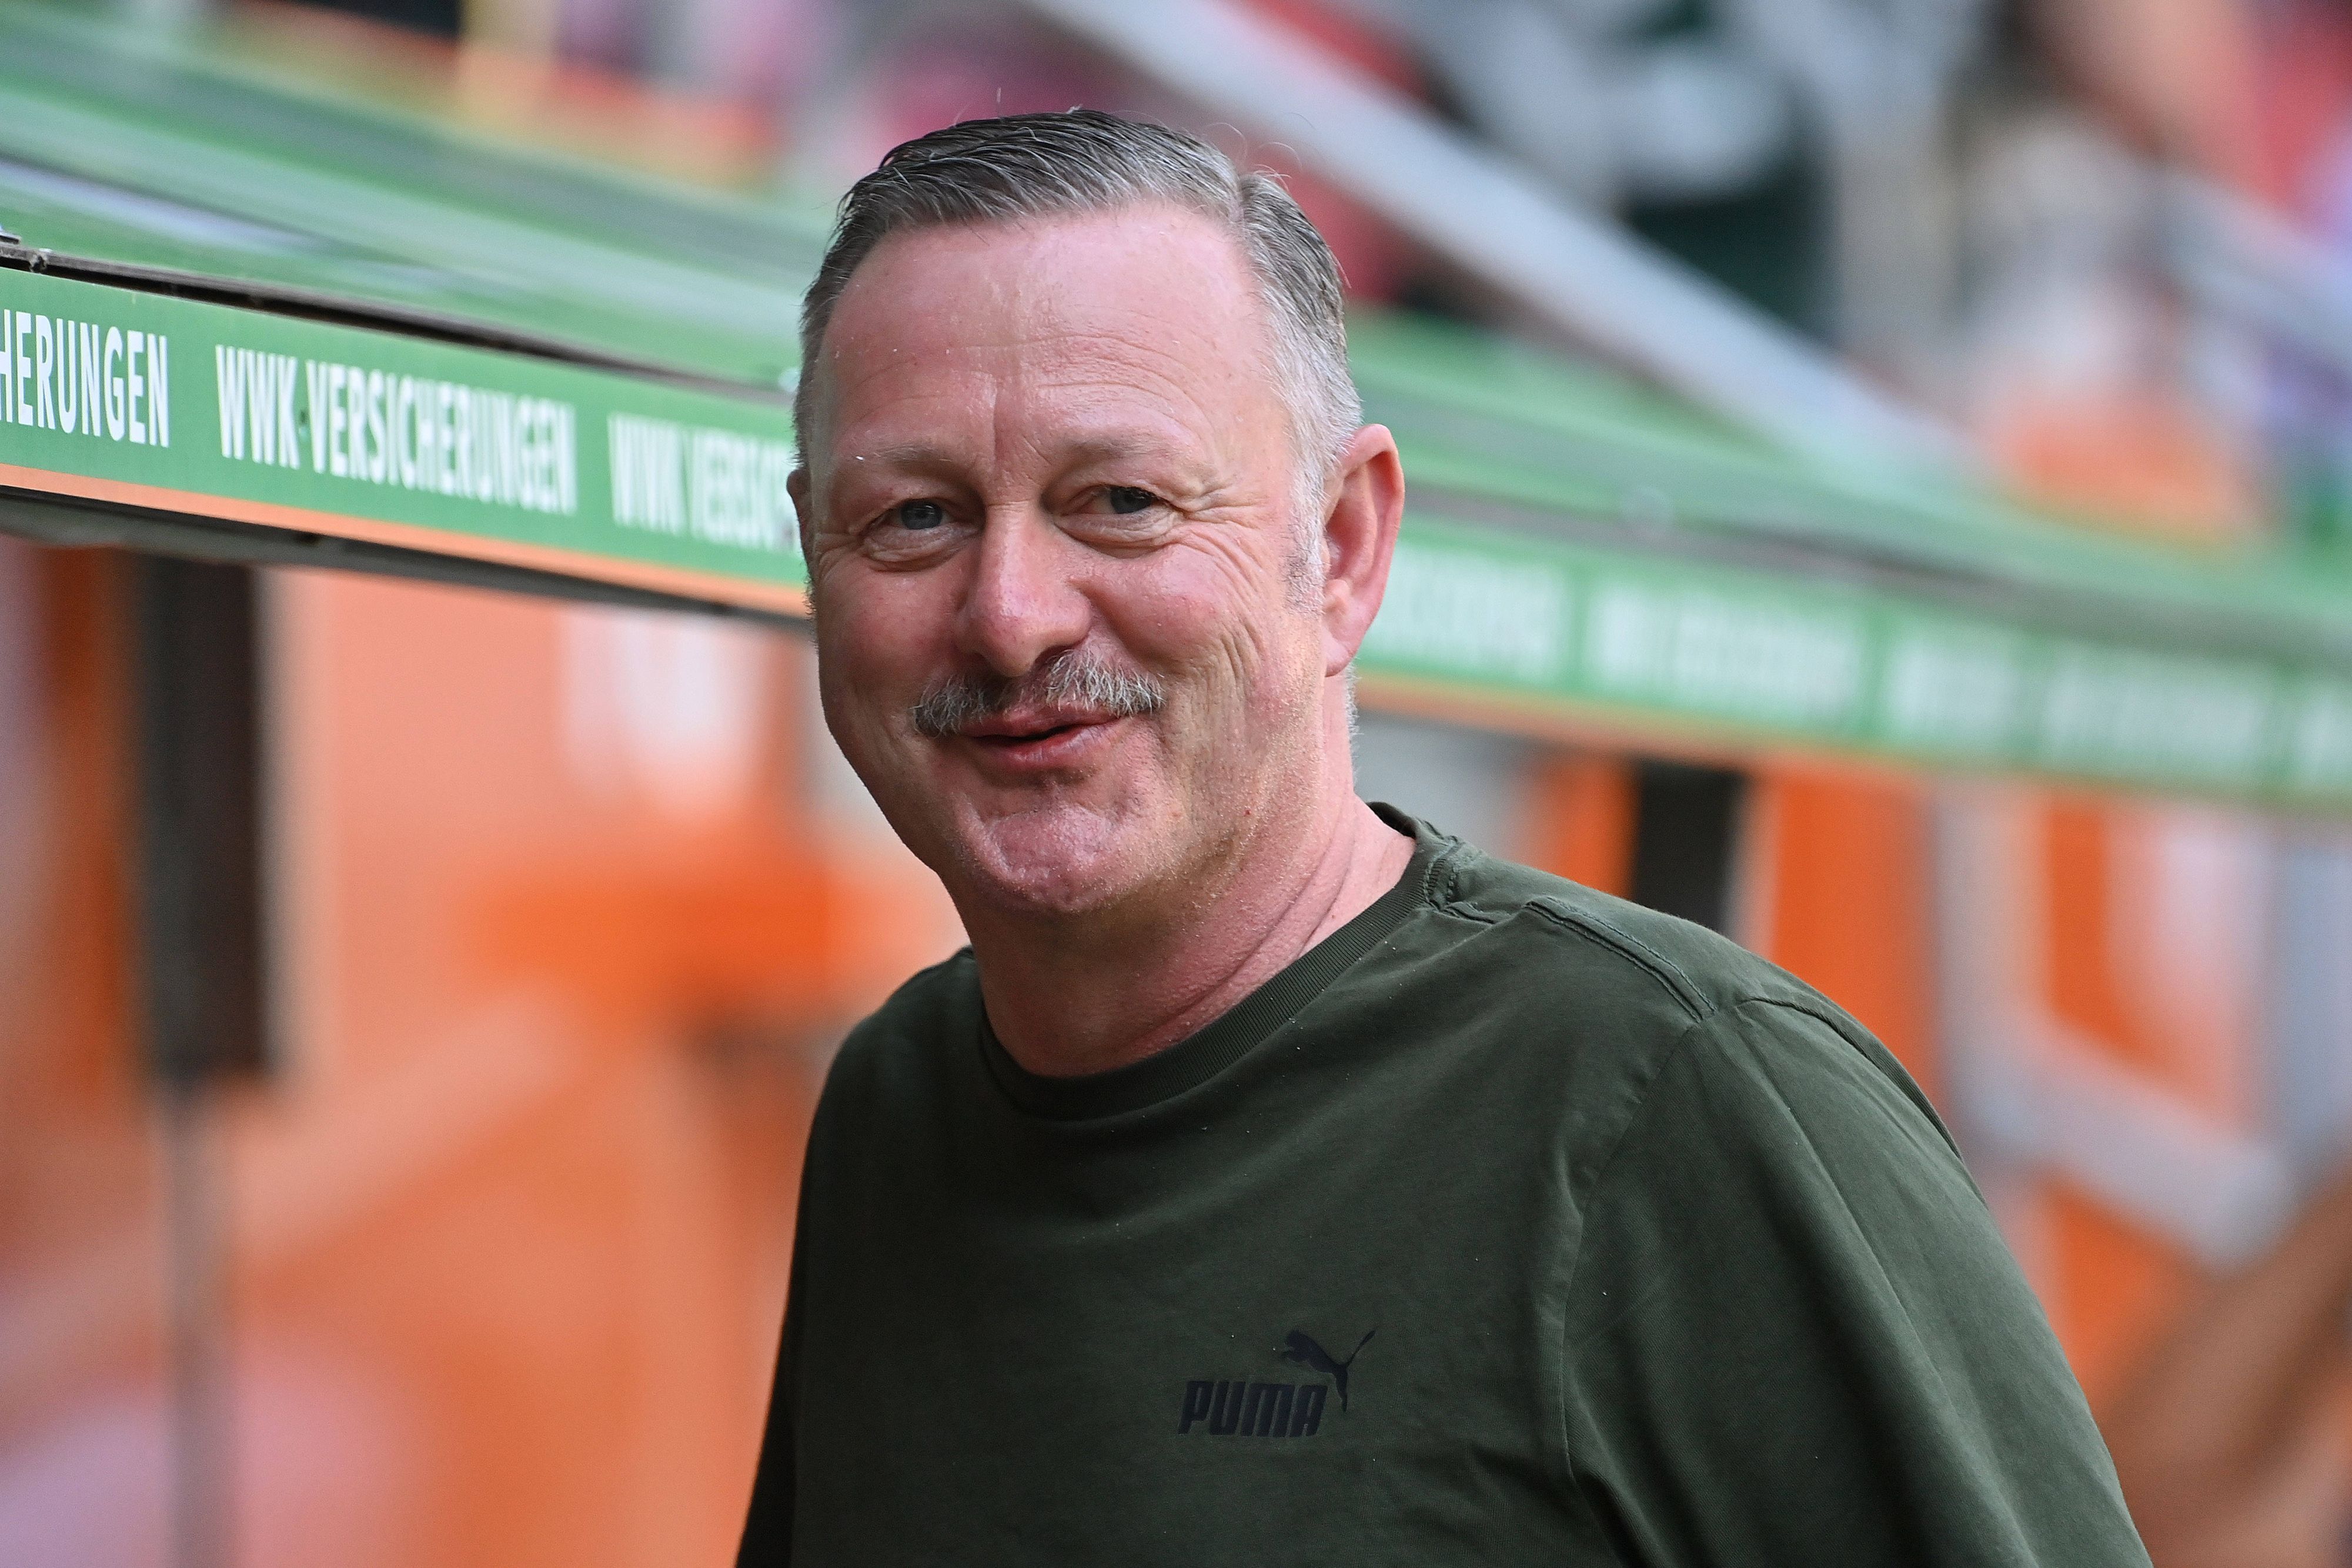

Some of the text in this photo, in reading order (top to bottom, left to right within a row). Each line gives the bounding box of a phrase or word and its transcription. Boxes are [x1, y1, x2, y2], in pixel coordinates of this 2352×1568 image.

[215, 343, 577, 516] WWK VERSICHERUNGEN
[1178, 1380, 1328, 1437] PUMA
